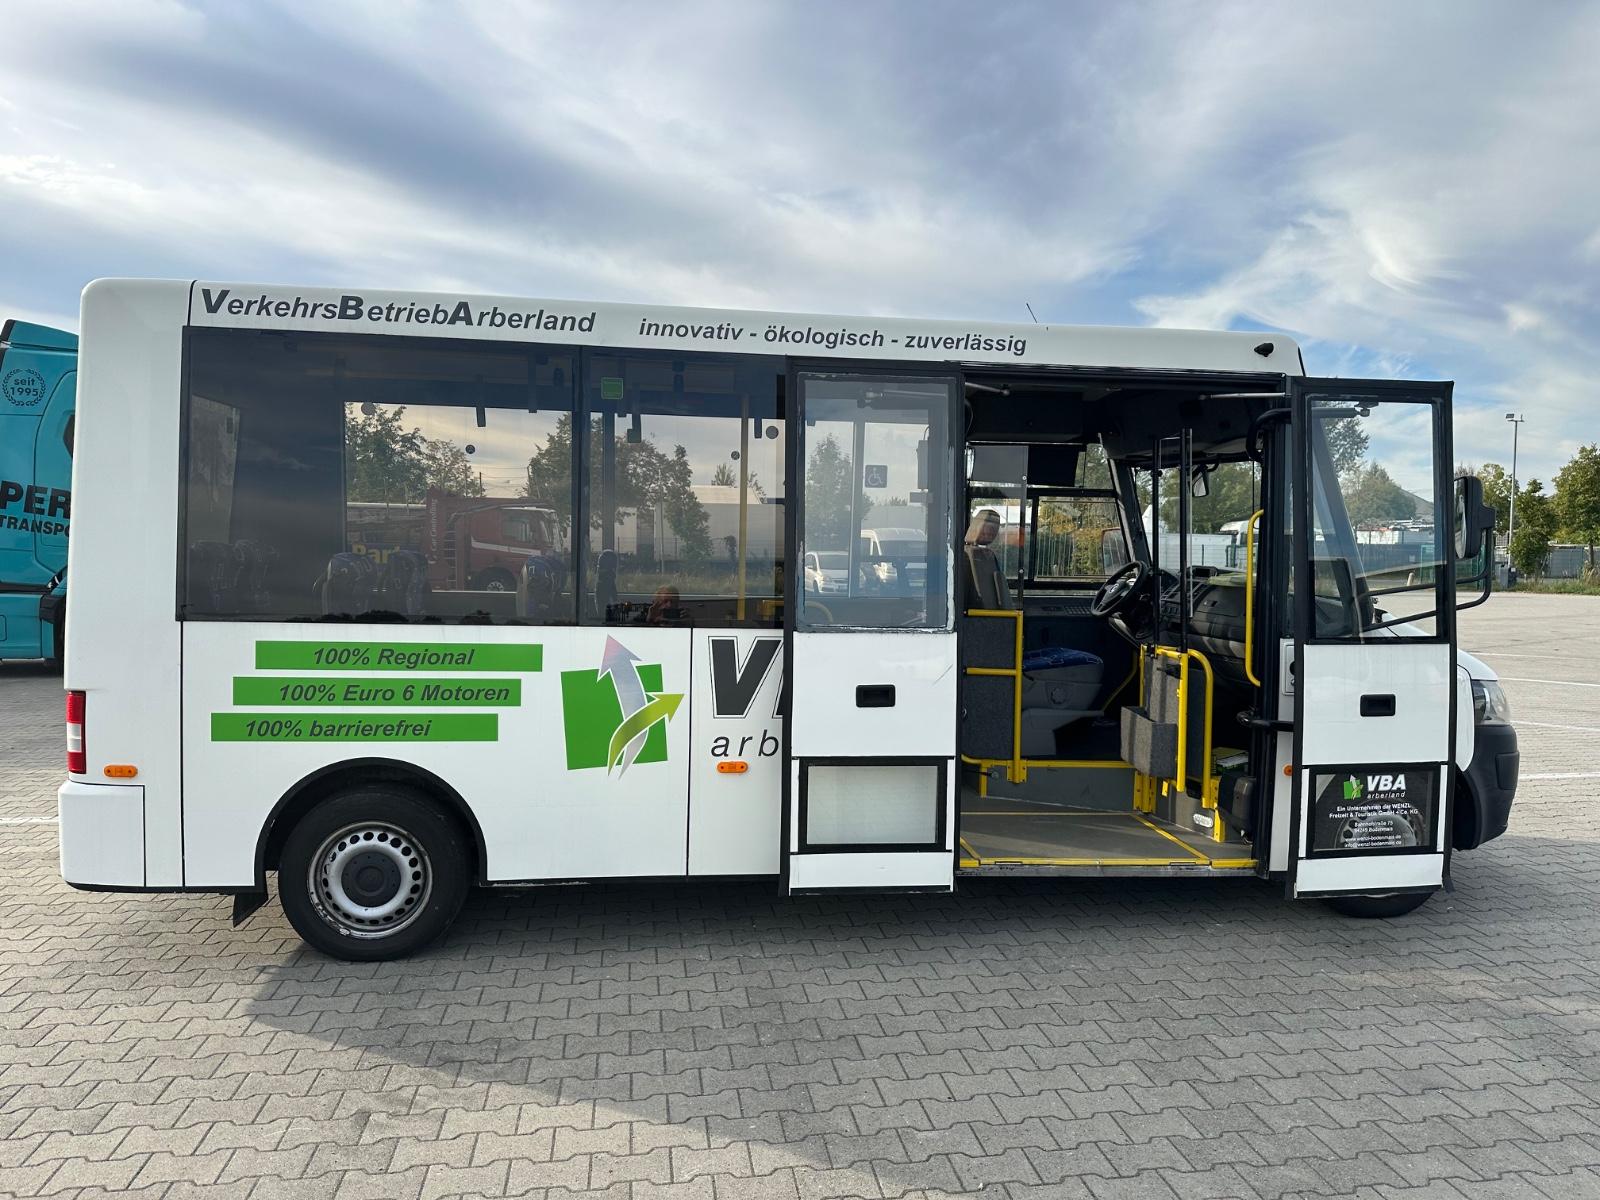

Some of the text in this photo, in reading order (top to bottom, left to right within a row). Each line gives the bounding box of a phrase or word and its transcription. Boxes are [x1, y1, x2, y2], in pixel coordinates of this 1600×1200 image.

[638, 318, 743, 341] innovativ
[763, 324, 884, 349] ökologisch
[904, 333, 1028, 355] zuverlässig
[14, 376, 36, 386] seit
[10, 387, 39, 397] 1995
[313, 647, 475, 669] 100% Regional
[708, 635, 784, 719] V
[279, 684, 511, 702] 100% Euro 6 Motoren
[245, 719, 432, 738] 100% barrierefrei
[711, 729, 779, 757] arb
[1367, 774, 1406, 791] VBA
[1367, 791, 1406, 799] arberland
